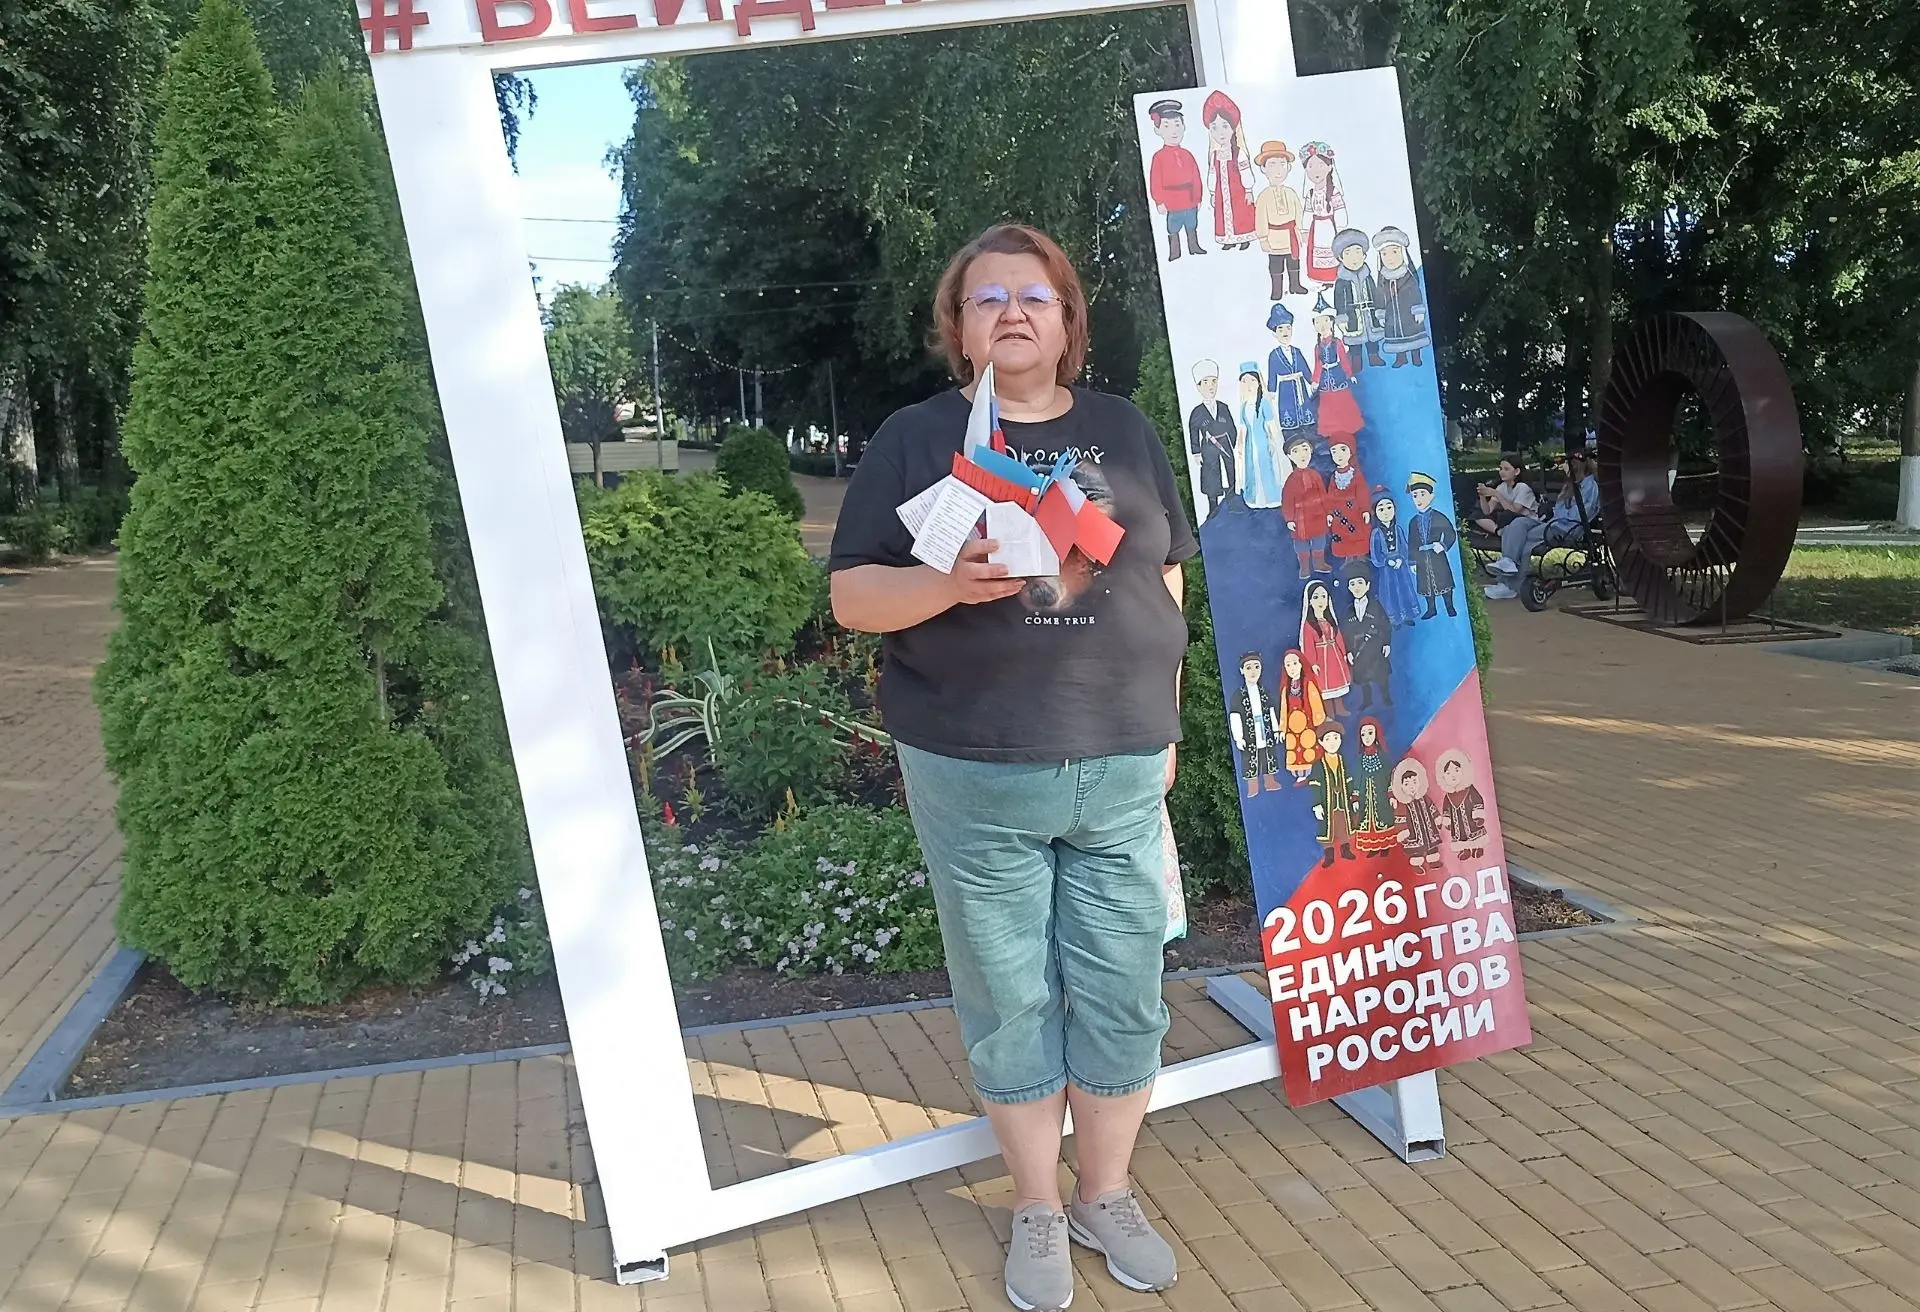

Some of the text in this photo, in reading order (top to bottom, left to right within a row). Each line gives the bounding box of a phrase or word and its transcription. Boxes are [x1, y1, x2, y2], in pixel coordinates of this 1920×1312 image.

[1024, 616, 1096, 626] COME TRUE
[1263, 866, 1510, 956] 2026 ГОД
[1267, 911, 1515, 1003] ЕДИНСТВА
[1288, 954, 1511, 1042] НАРОДОВ
[1306, 998, 1496, 1082] РОССИИ
